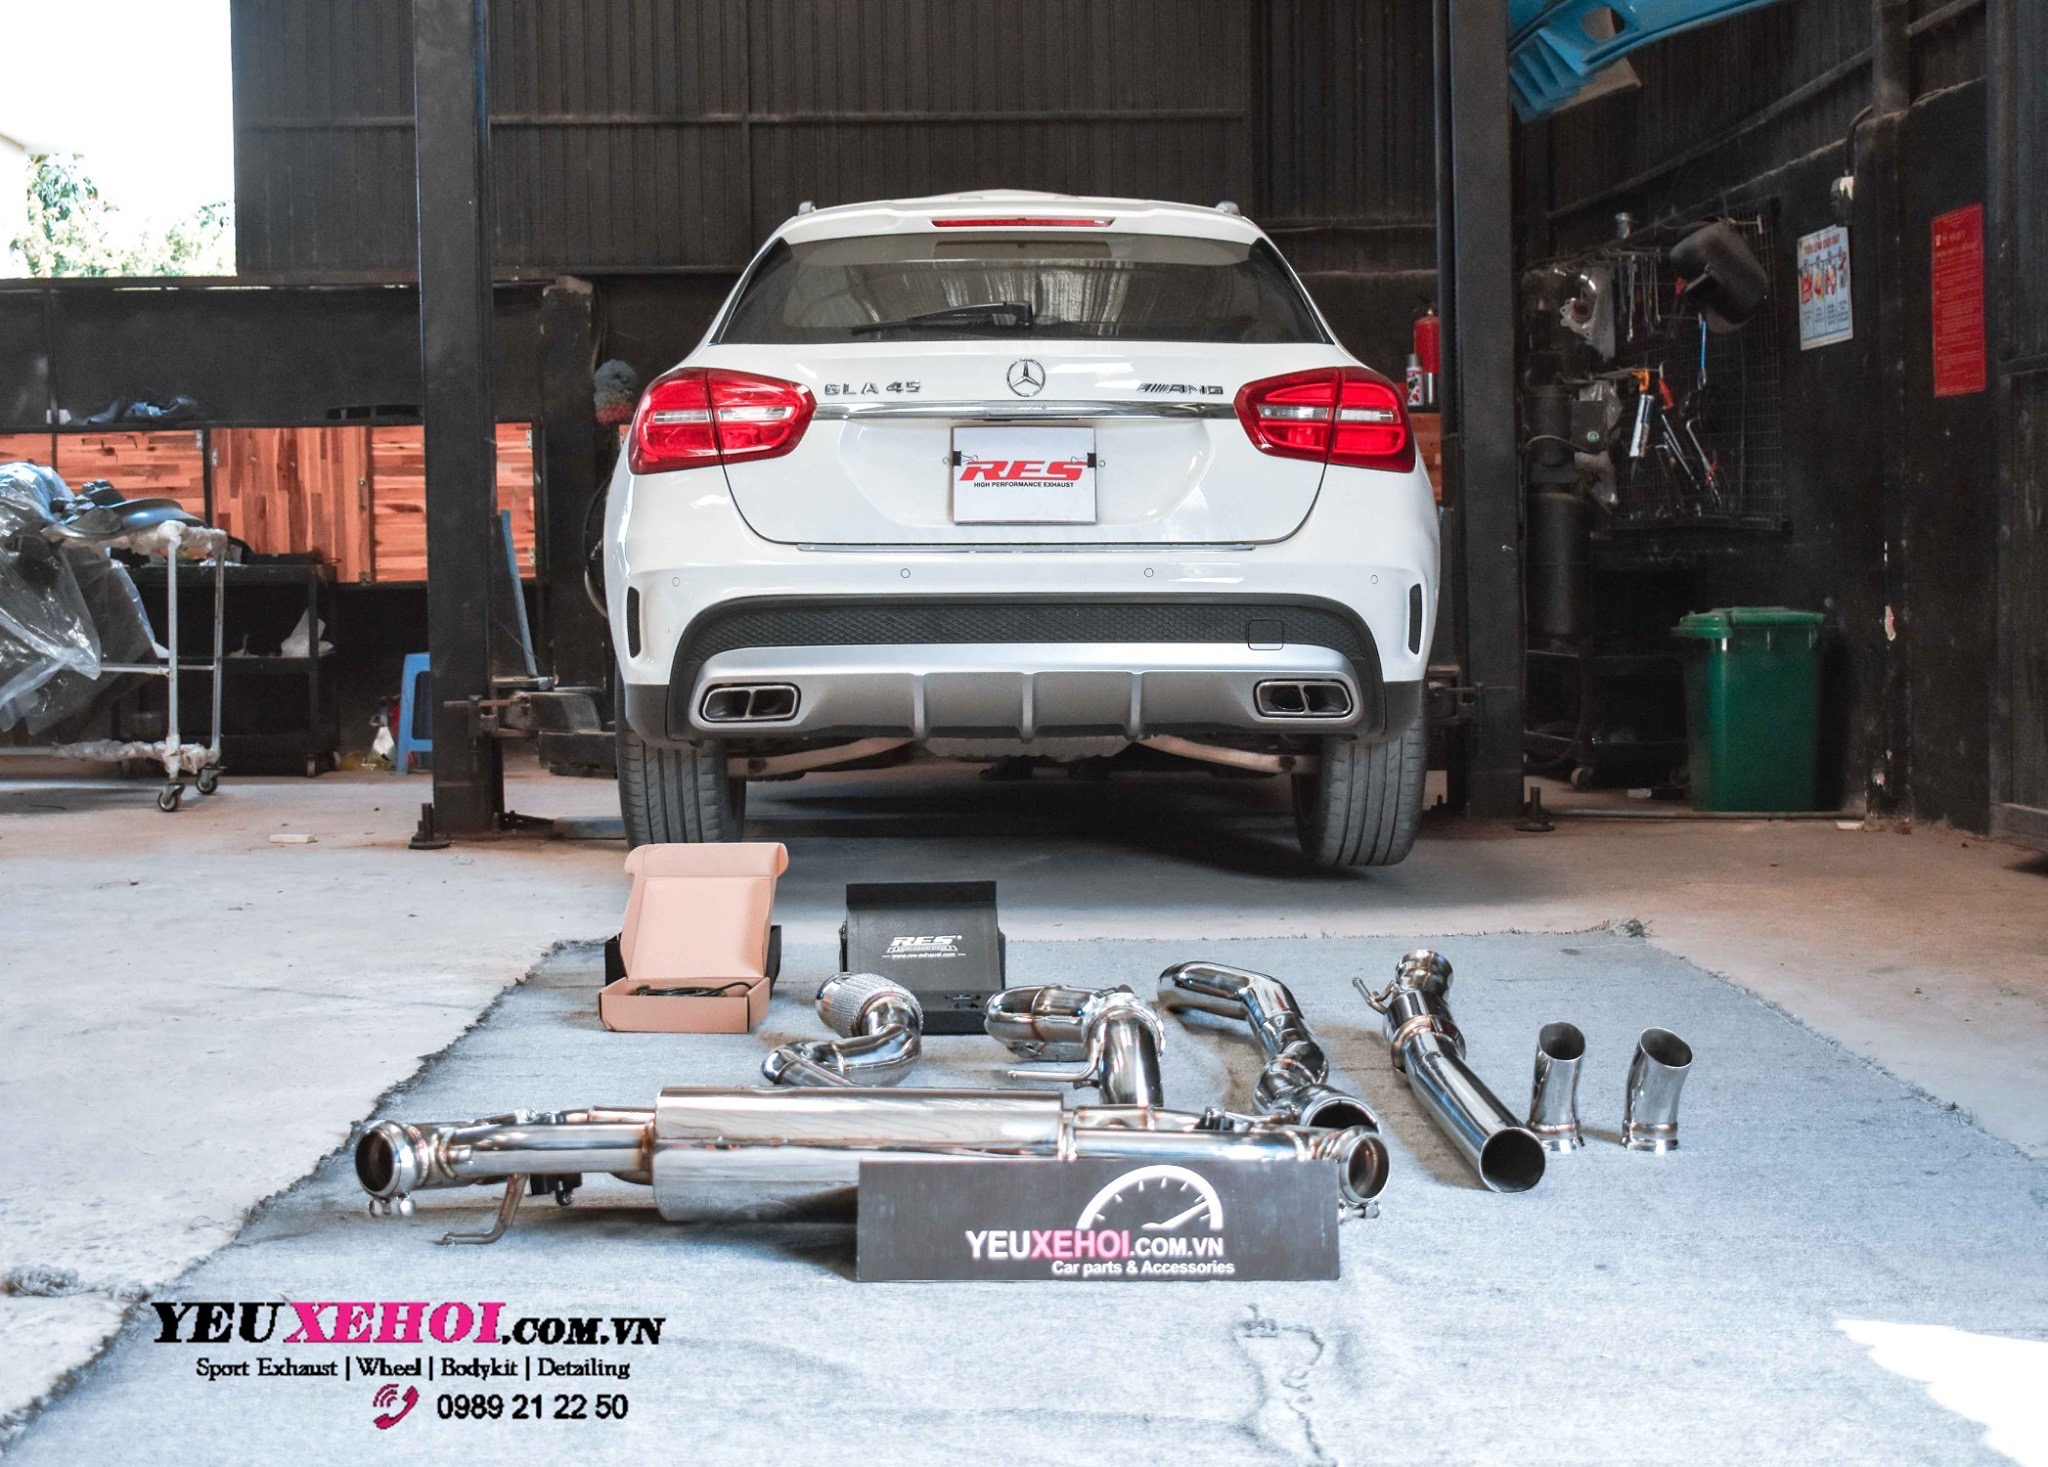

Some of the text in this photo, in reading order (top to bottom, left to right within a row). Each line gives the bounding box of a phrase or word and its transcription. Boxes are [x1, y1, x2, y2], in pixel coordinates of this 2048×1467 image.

[824, 380, 921, 396] GLA 45
[1167, 383, 1224, 395] AMG
[960, 460, 1089, 481] RES
[890, 935, 957, 947] RES
[965, 1229, 1224, 1260] YEUXEHOI.COM.VN
[1051, 1260, 1235, 1276] Car parts & Accessories
